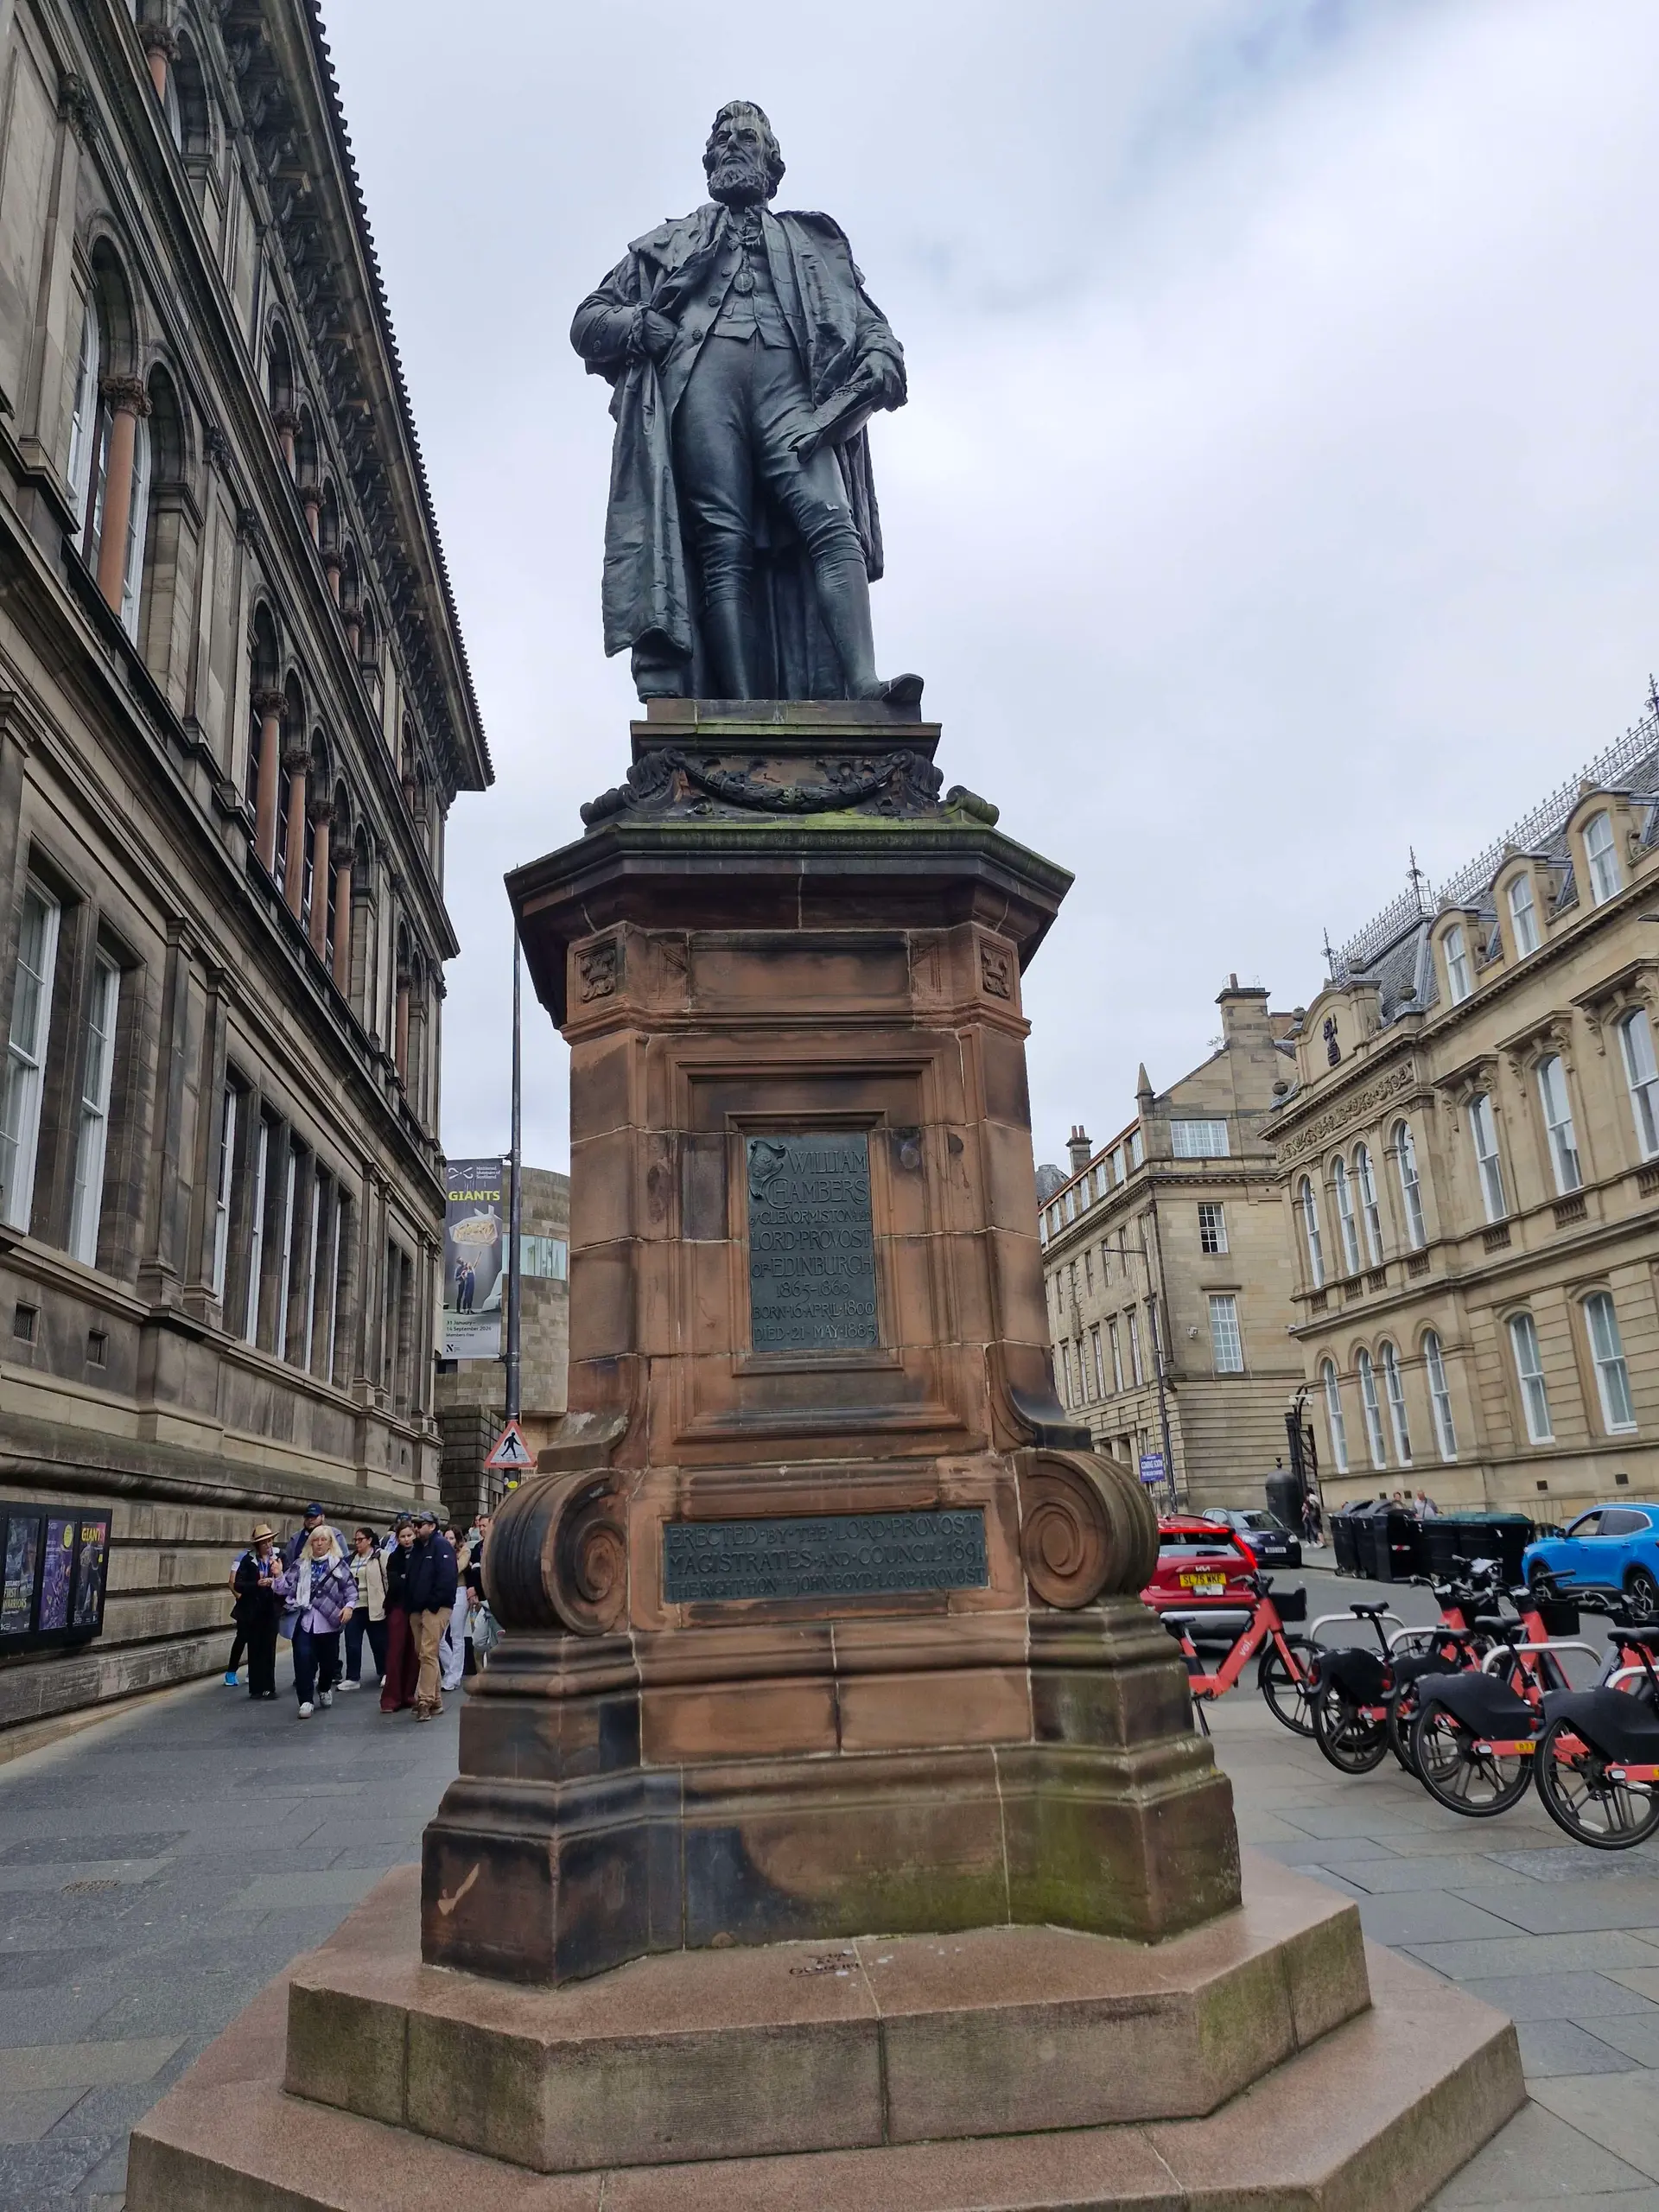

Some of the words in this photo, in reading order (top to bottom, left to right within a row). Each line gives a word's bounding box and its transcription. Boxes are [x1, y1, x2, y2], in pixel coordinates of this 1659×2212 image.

[785, 1149, 868, 1173] WILLIAM
[448, 1191, 500, 1201] GIANTS
[764, 1178, 869, 1210] CHAMBERS
[751, 1231, 796, 1251] LORD
[799, 1228, 872, 1250] PROVOST
[771, 1255, 874, 1279] EDINBURGH
[752, 1305, 787, 1320] BORN
[790, 1302, 802, 1319] 16
[805, 1303, 840, 1321] APRIL
[843, 1300, 874, 1317] 1800
[753, 1325, 785, 1342] DIED
[791, 1326, 805, 1340] 21
[814, 1325, 840, 1339] MAY
[844, 1321, 876, 1344] 1883
[669, 1526, 759, 1552] ERECTED
[766, 1528, 789, 1544] BY
[796, 1525, 828, 1542] THE
[835, 1520, 887, 1541] LORD
[891, 1514, 982, 1538] PROVOST
[668, 1548, 813, 1575] MAGISTRATES
[817, 1550, 851, 1568] AND
[857, 1541, 942, 1566] COUNCIL
[946, 1537, 984, 1565] 1891
[832, 1571, 874, 1588] BOYD
[878, 1568, 916, 1588] LORD
[919, 1565, 986, 1588] PROVOST
